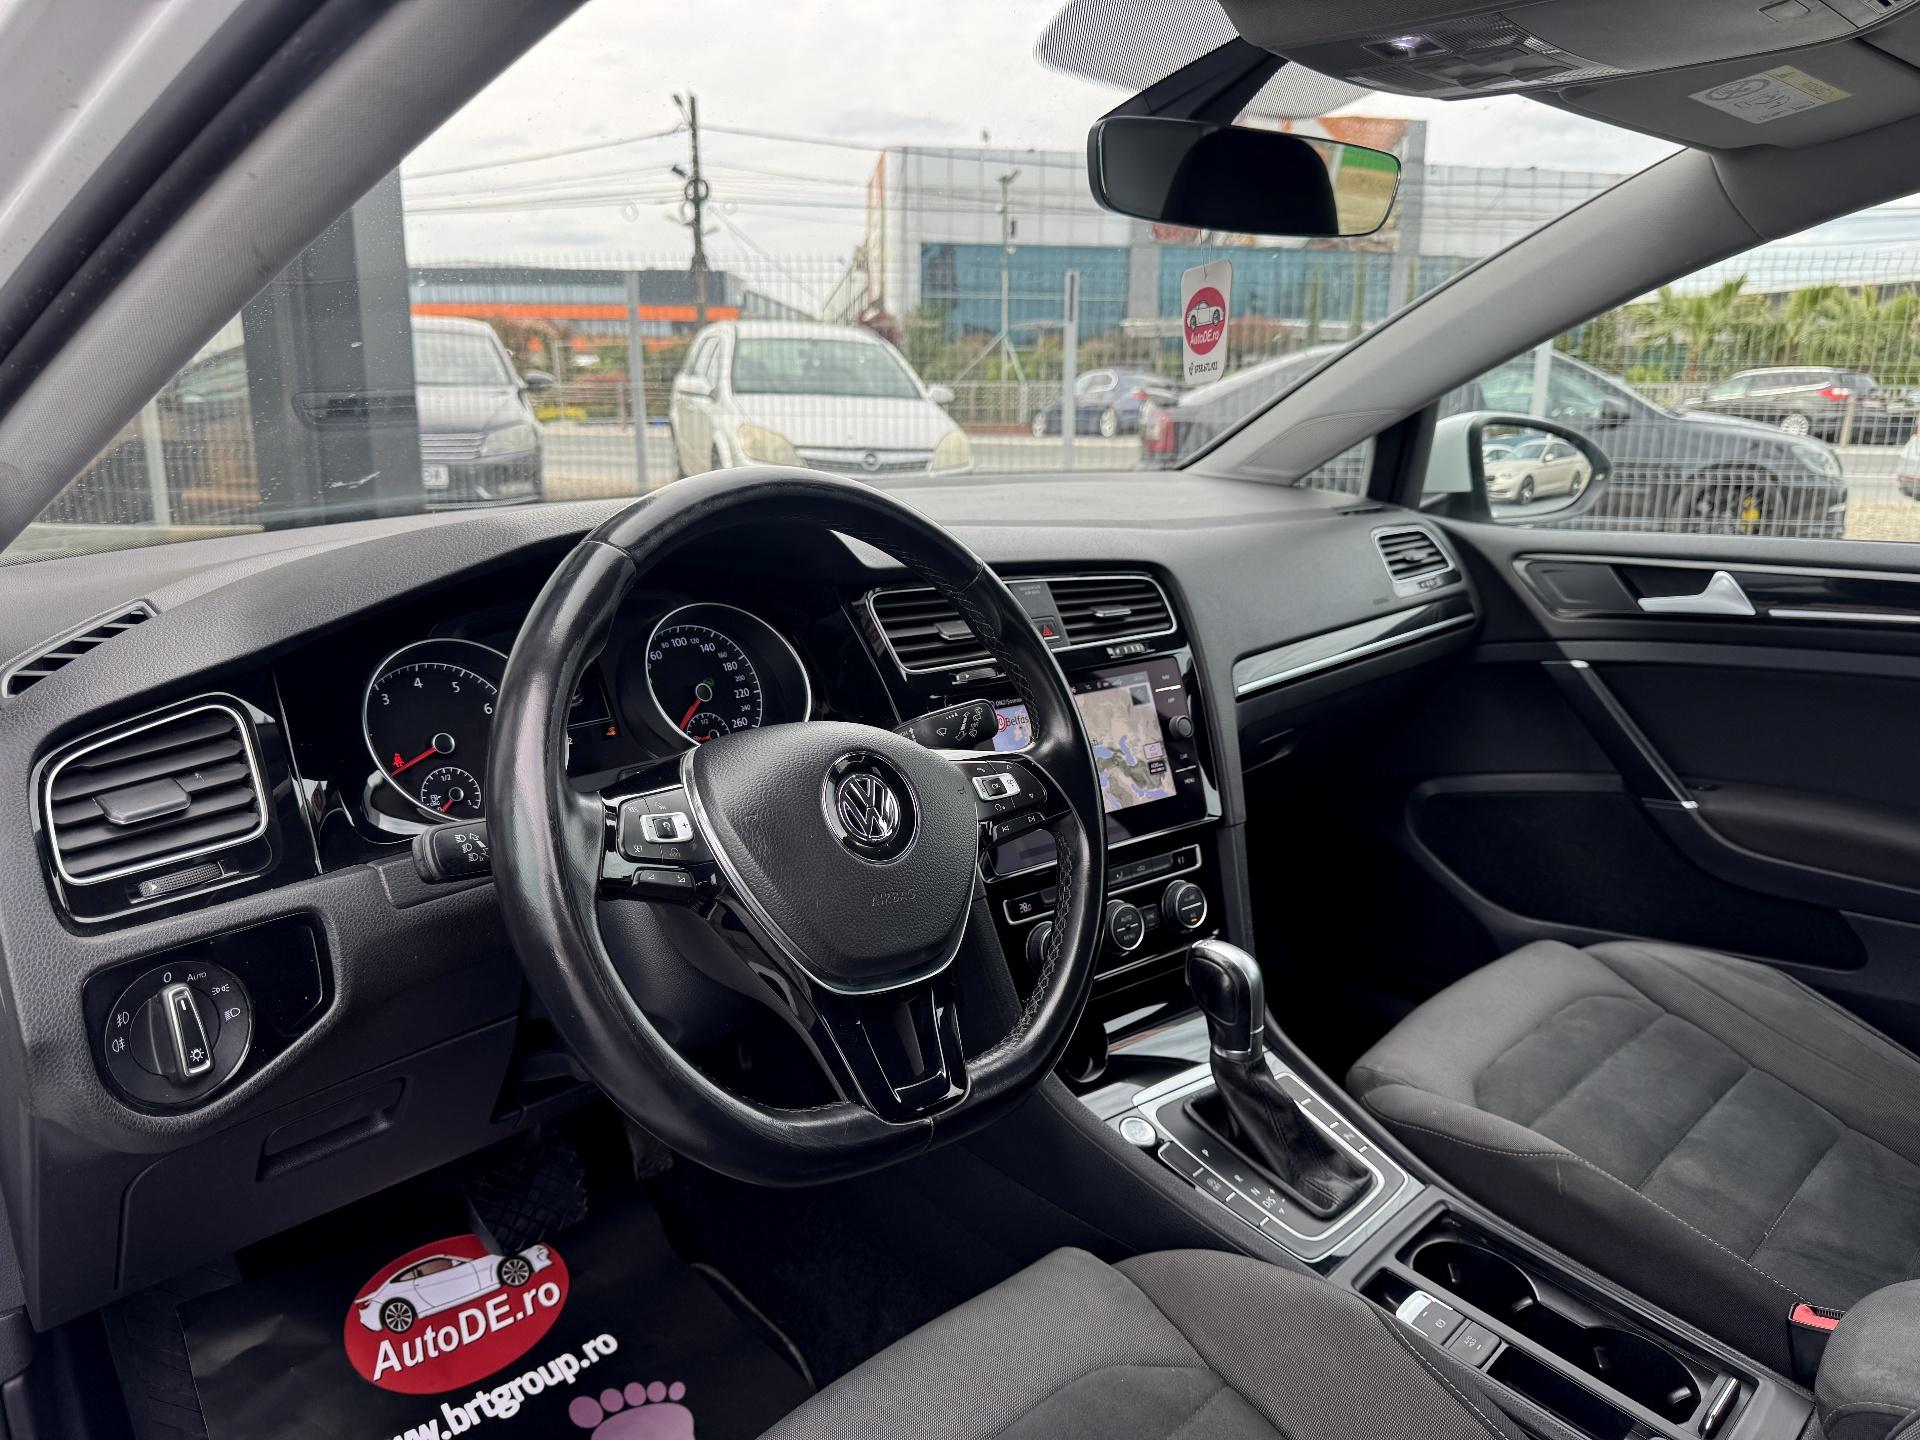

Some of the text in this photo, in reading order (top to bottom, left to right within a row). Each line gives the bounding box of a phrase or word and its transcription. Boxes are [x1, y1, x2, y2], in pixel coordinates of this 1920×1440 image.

[1189, 329, 1219, 346] AutoDE.ro
[671, 636, 688, 648] 100
[700, 642, 716, 654] 140
[649, 650, 663, 661] 60
[722, 661, 738, 672] 180
[413, 677, 424, 689] 4
[451, 681, 461, 693] 5
[734, 687, 750, 699] 220
[381, 693, 390, 706] 3
[483, 702, 493, 715] 6
[731, 716, 748, 729] 260
[373, 1281, 562, 1381] AutoDE.ro
